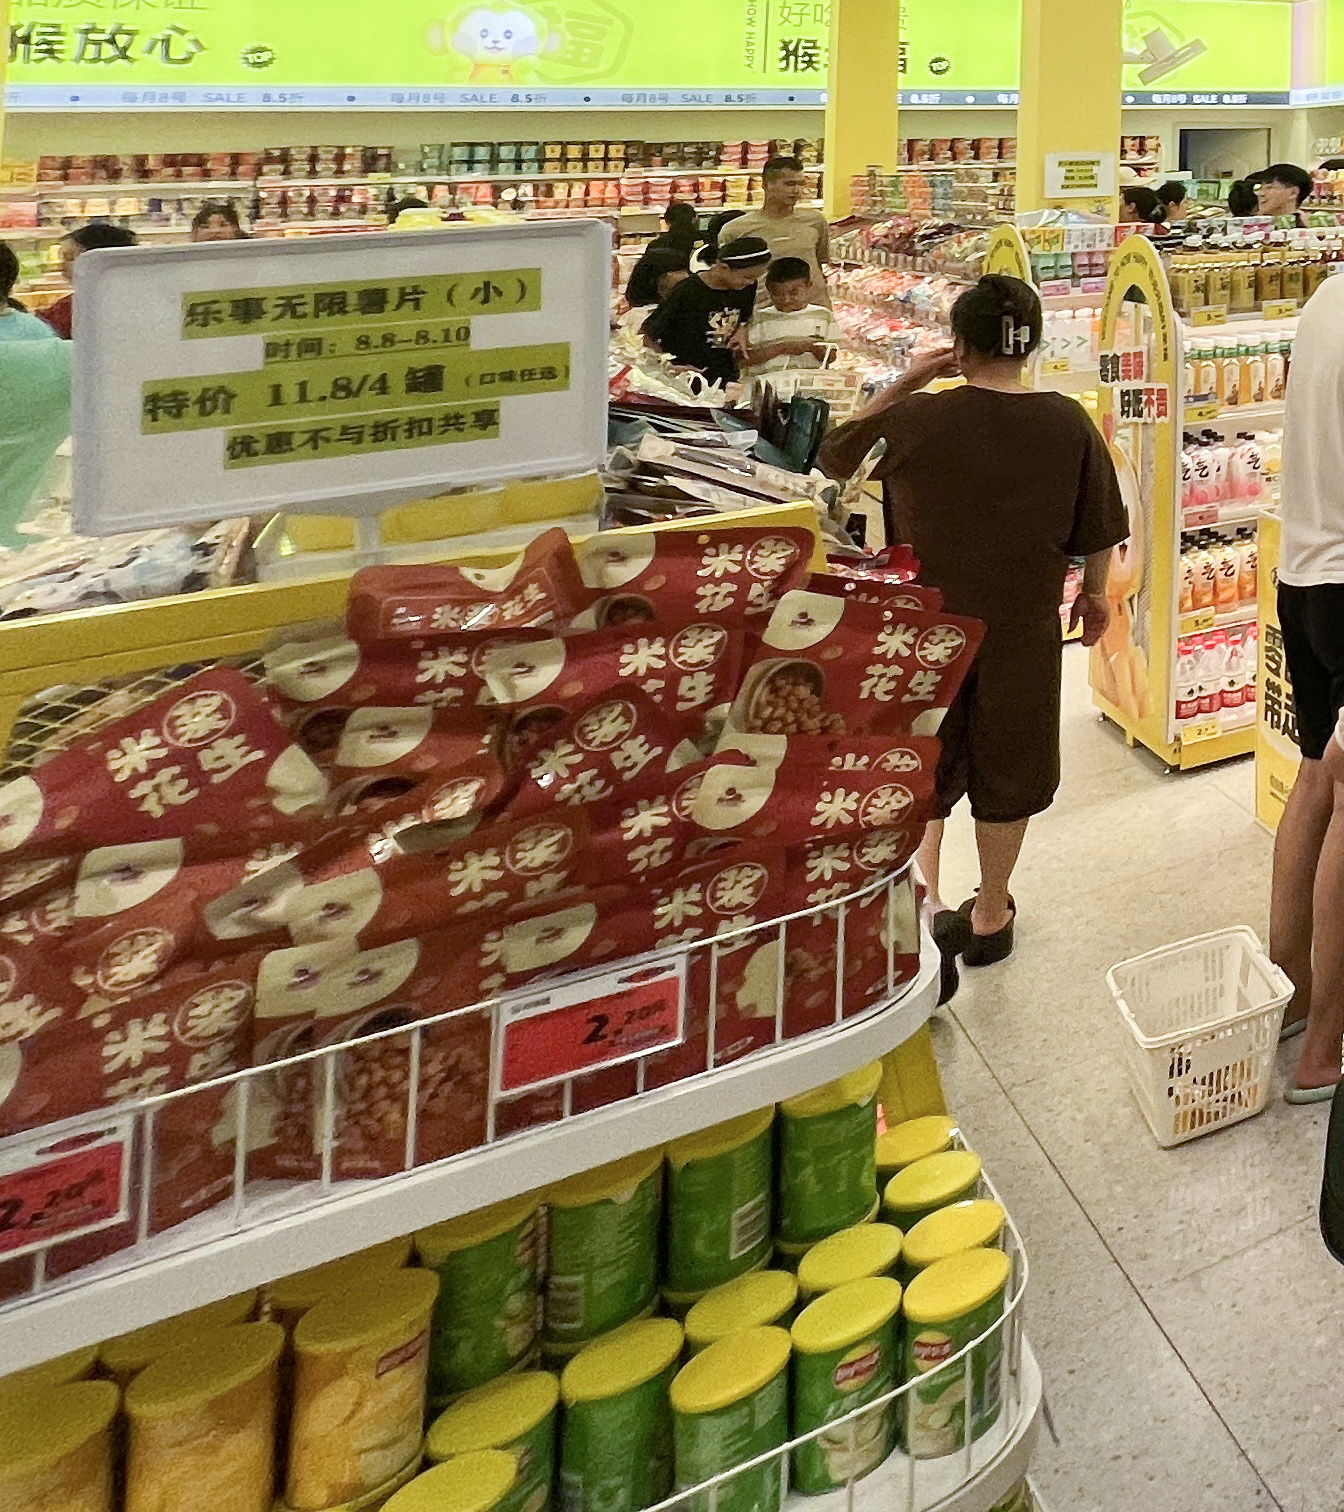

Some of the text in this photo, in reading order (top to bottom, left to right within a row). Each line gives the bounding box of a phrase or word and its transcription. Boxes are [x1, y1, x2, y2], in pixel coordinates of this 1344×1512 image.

[9, 21, 209, 65] 猴放心
[744, 0, 758, 70] HOW HAPPY
[202, 92, 247, 103] SALE
[460, 93, 498, 103] SALE
[681, 93, 714, 103] SALE
[354, 324, 471, 352] 8.8-8.10
[143, 385, 237, 423] 特价
[265, 372, 389, 408] 11.8/4
[404, 364, 446, 395] 罐
[226, 407, 500, 461] 优惠不与折扣共享
[859, 663, 942, 702] 花生
[128, 734, 266, 820] 花生
